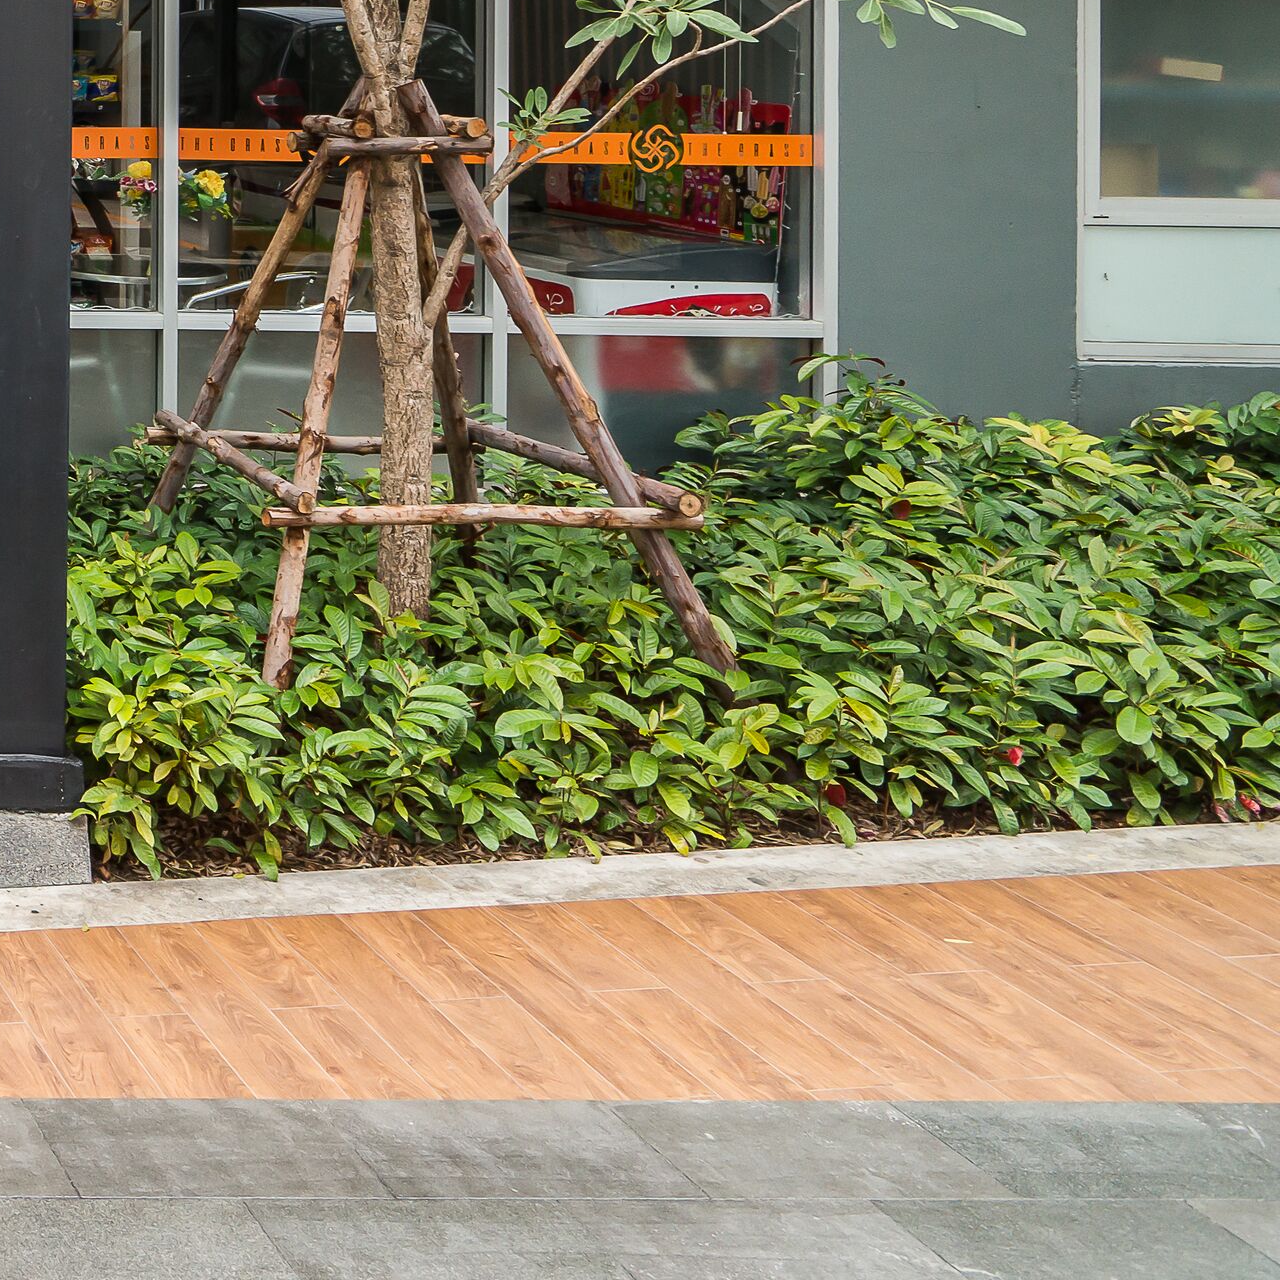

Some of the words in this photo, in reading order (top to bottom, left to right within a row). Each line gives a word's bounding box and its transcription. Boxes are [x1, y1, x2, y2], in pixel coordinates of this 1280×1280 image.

[84, 135, 151, 151] GRASS
[180, 136, 215, 152] THE
[687, 142, 723, 157] THE
